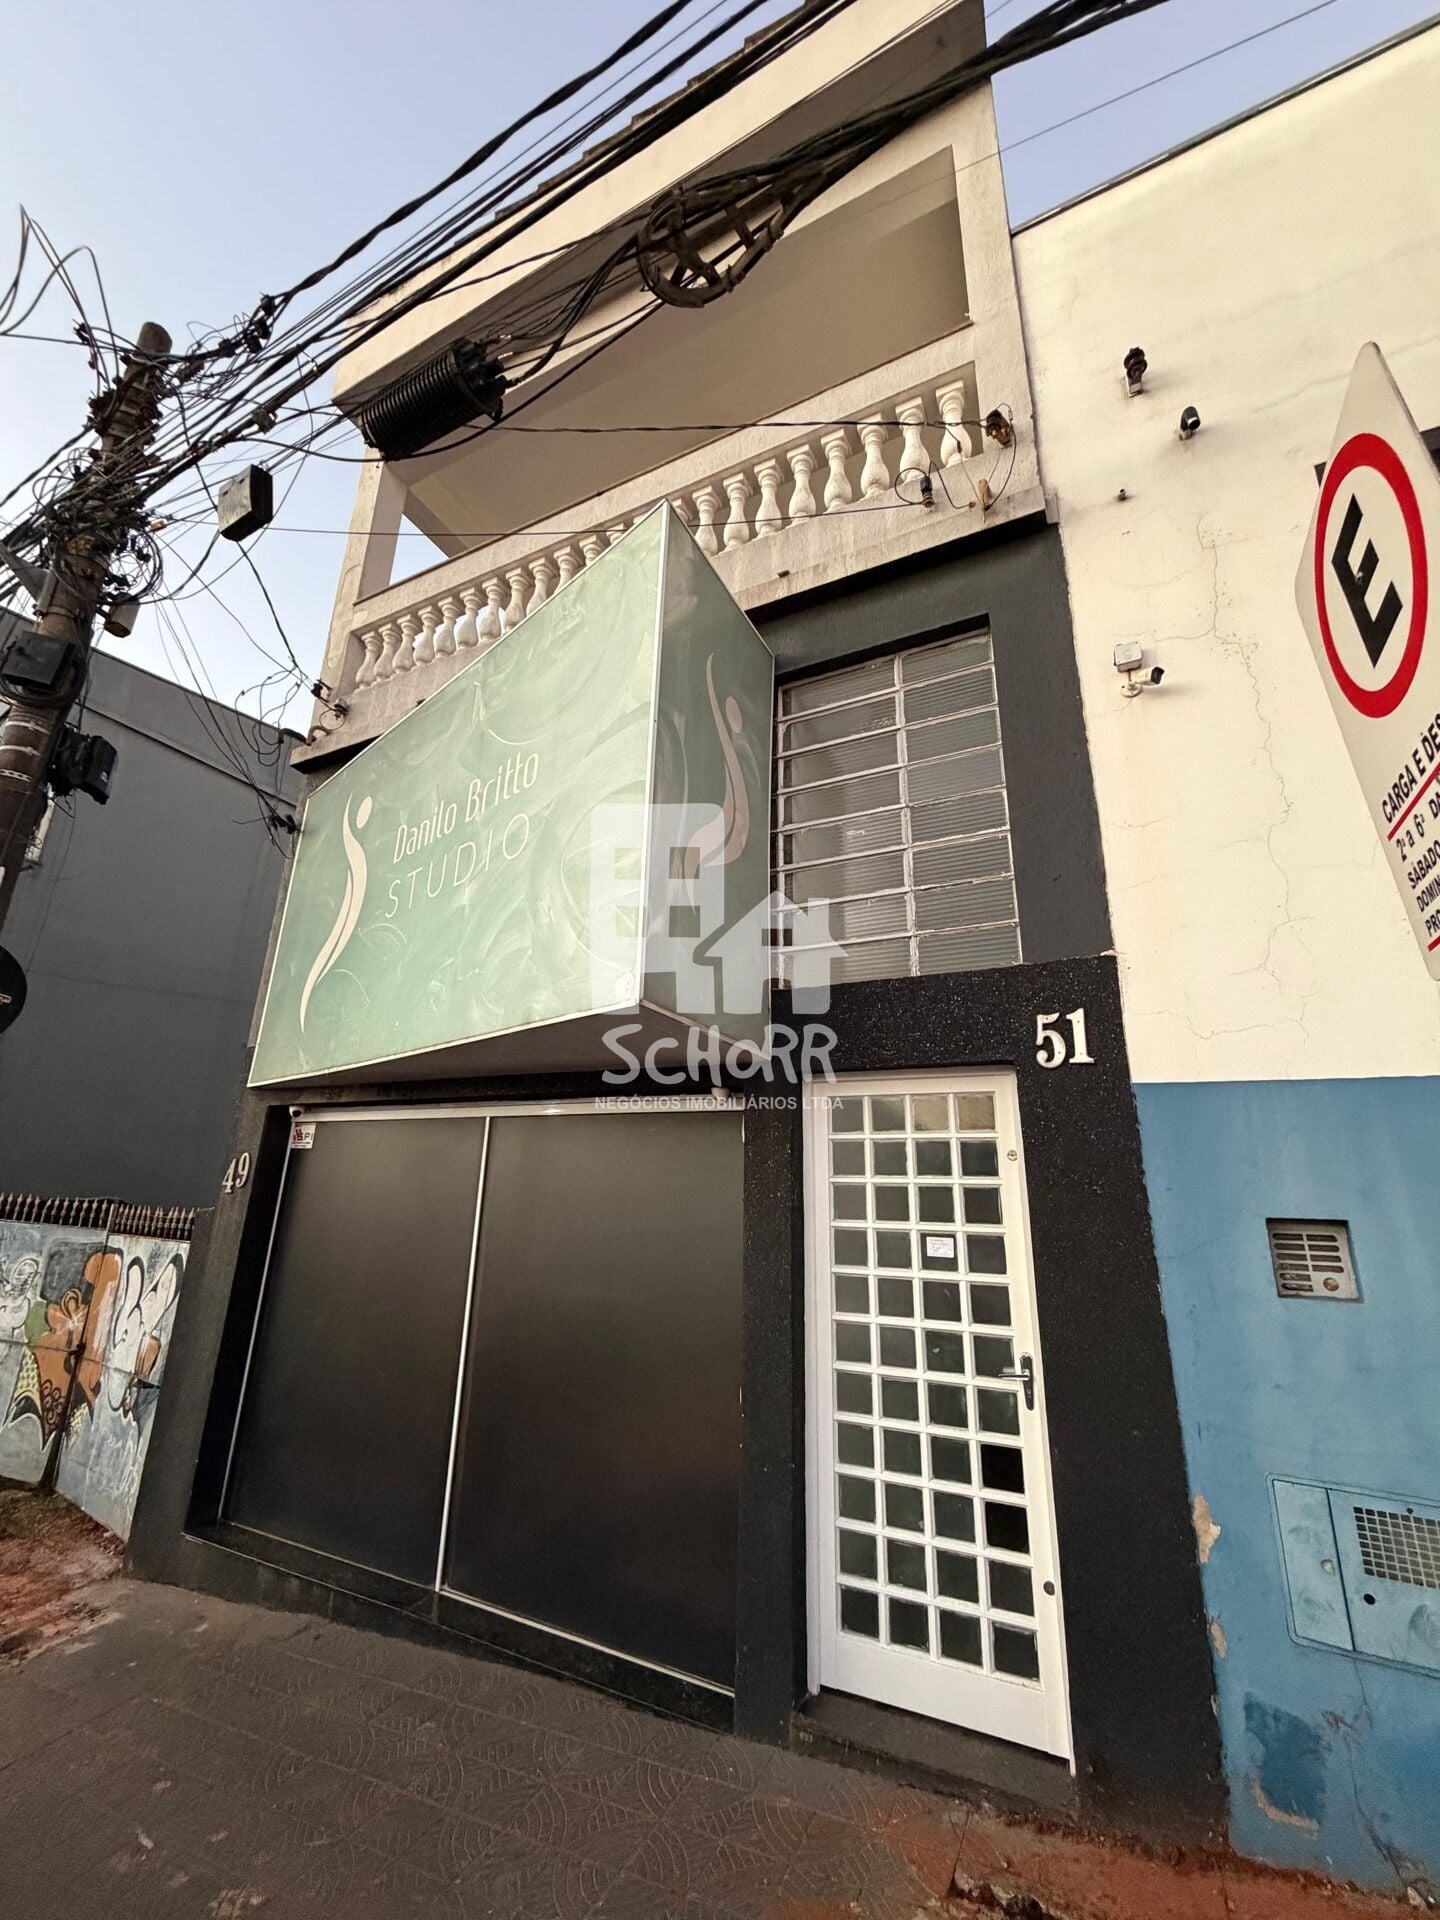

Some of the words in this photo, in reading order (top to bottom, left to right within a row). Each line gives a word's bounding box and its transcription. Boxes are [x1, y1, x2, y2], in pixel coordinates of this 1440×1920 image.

[1331, 493, 1403, 669] E
[393, 801, 457, 864] Danilo
[465, 752, 539, 822] Britto
[1382, 764, 1418, 823] CARGA
[1412, 748, 1426, 777] E
[385, 813, 529, 918] STUDIO
[1406, 830, 1415, 848] a
[1036, 1008, 1095, 1069] 51
[222, 1152, 250, 1193] 49
